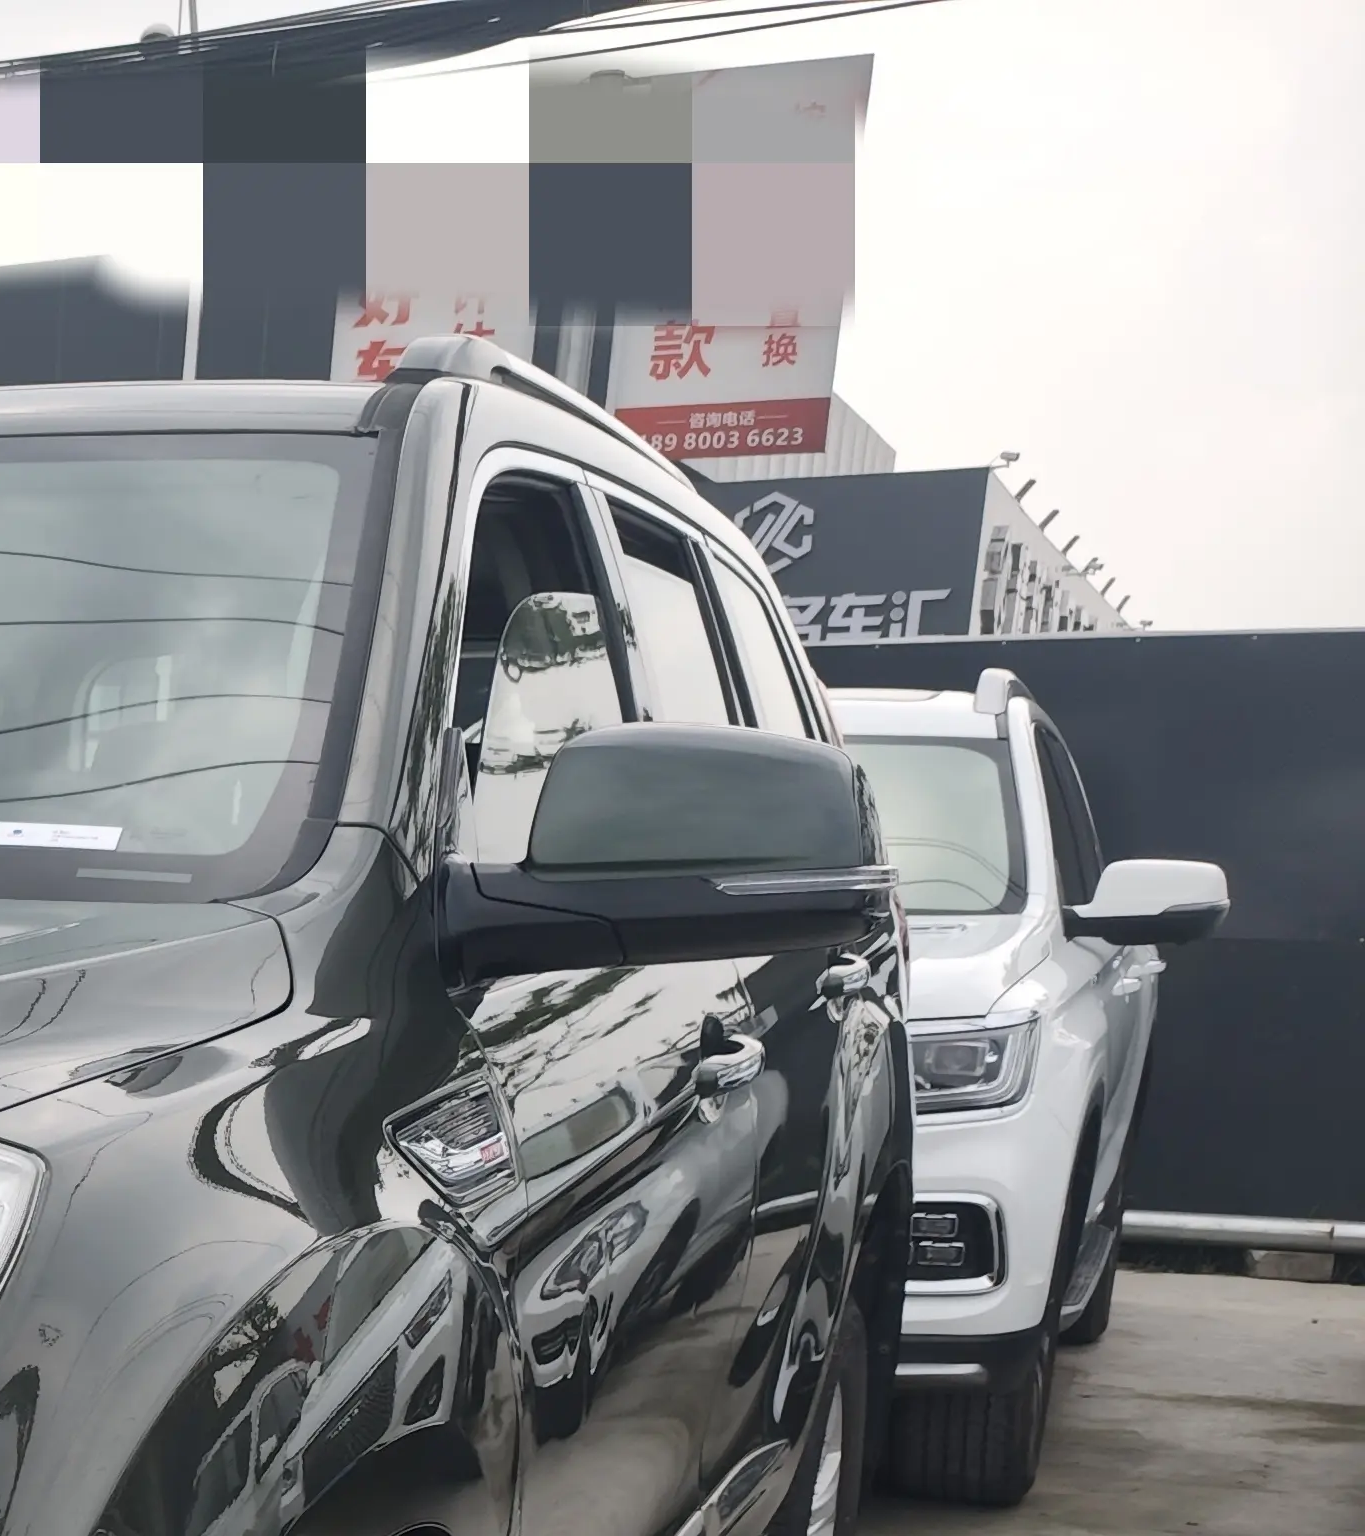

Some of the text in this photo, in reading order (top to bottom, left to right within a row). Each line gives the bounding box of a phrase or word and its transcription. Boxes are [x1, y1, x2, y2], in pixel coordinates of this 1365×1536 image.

[688, 409, 757, 429] 咨询电话
[683, 430, 740, 450] 8003
[746, 427, 804, 448] 6623
